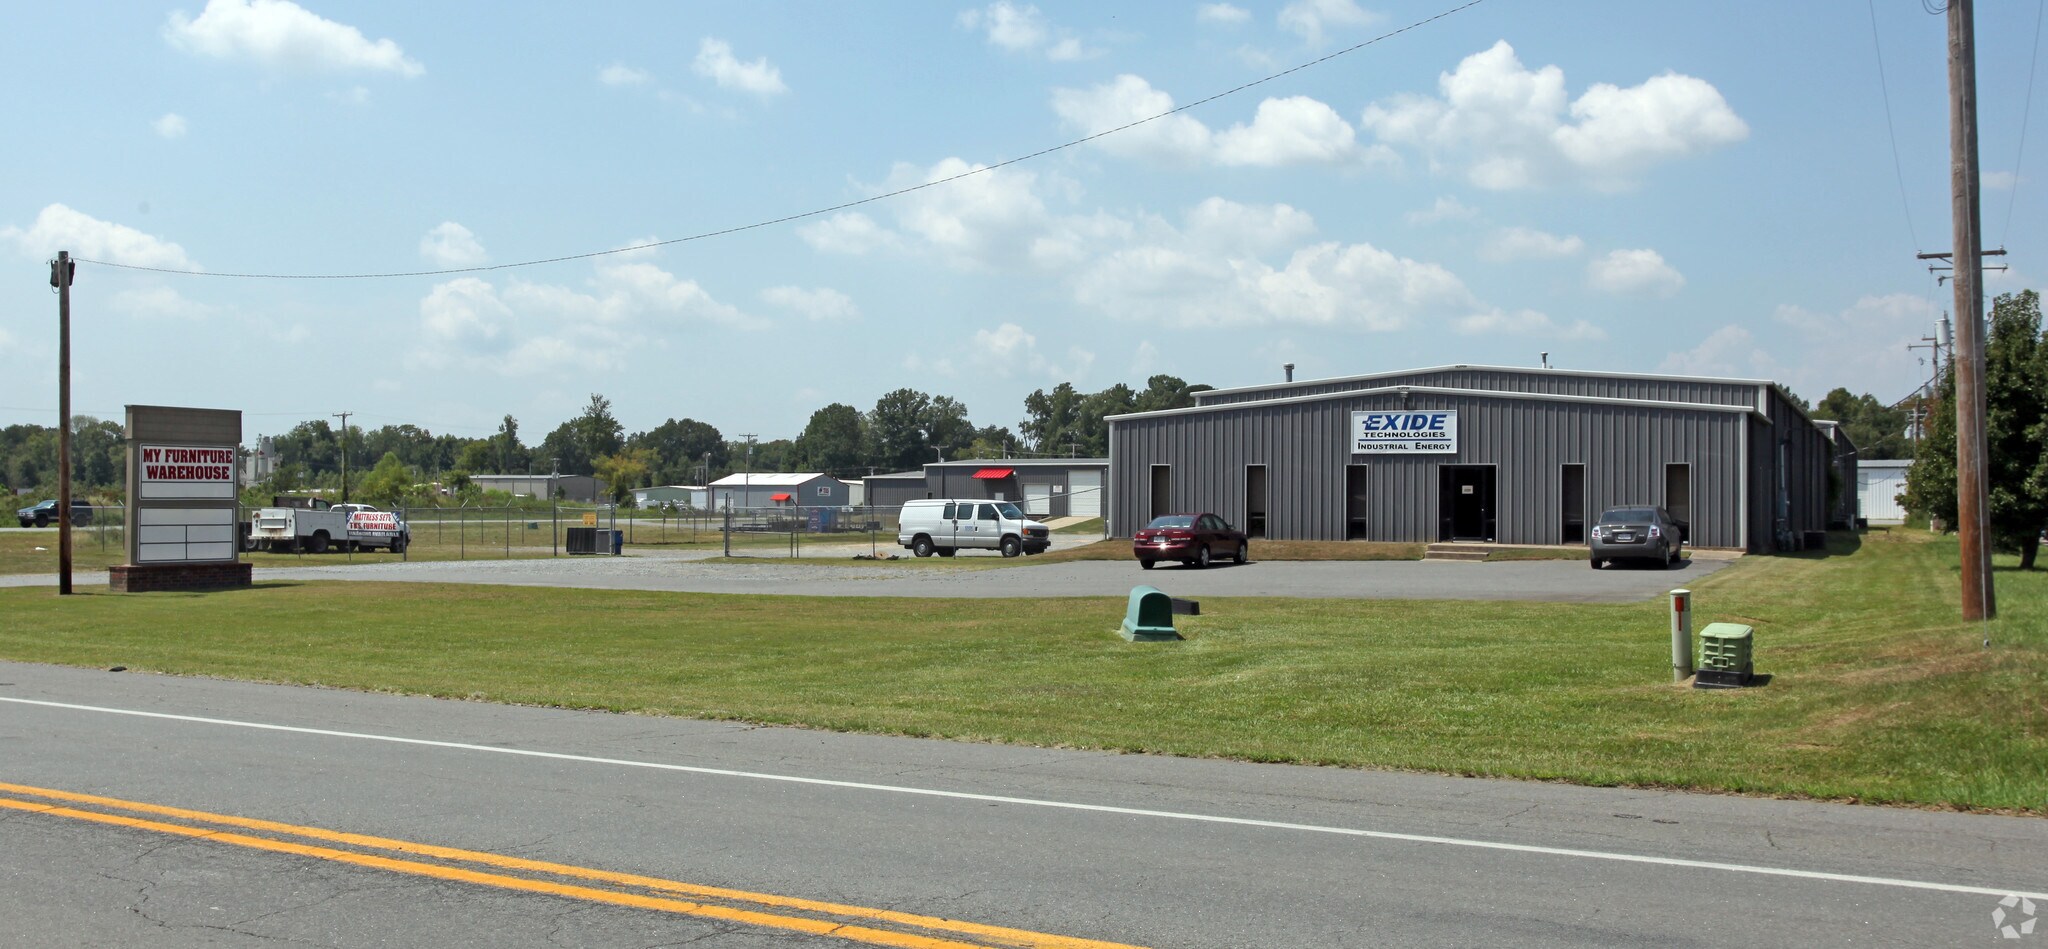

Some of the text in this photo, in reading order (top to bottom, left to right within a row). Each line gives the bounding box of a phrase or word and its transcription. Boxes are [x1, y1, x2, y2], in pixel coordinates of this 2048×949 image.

[1362, 414, 1447, 430] EXIDE
[143, 448, 233, 464] MY FURNITURE
[146, 465, 230, 480] WAREHOUSE
[354, 513, 379, 521] MATTRESS
[363, 522, 396, 530] FURNITURE
